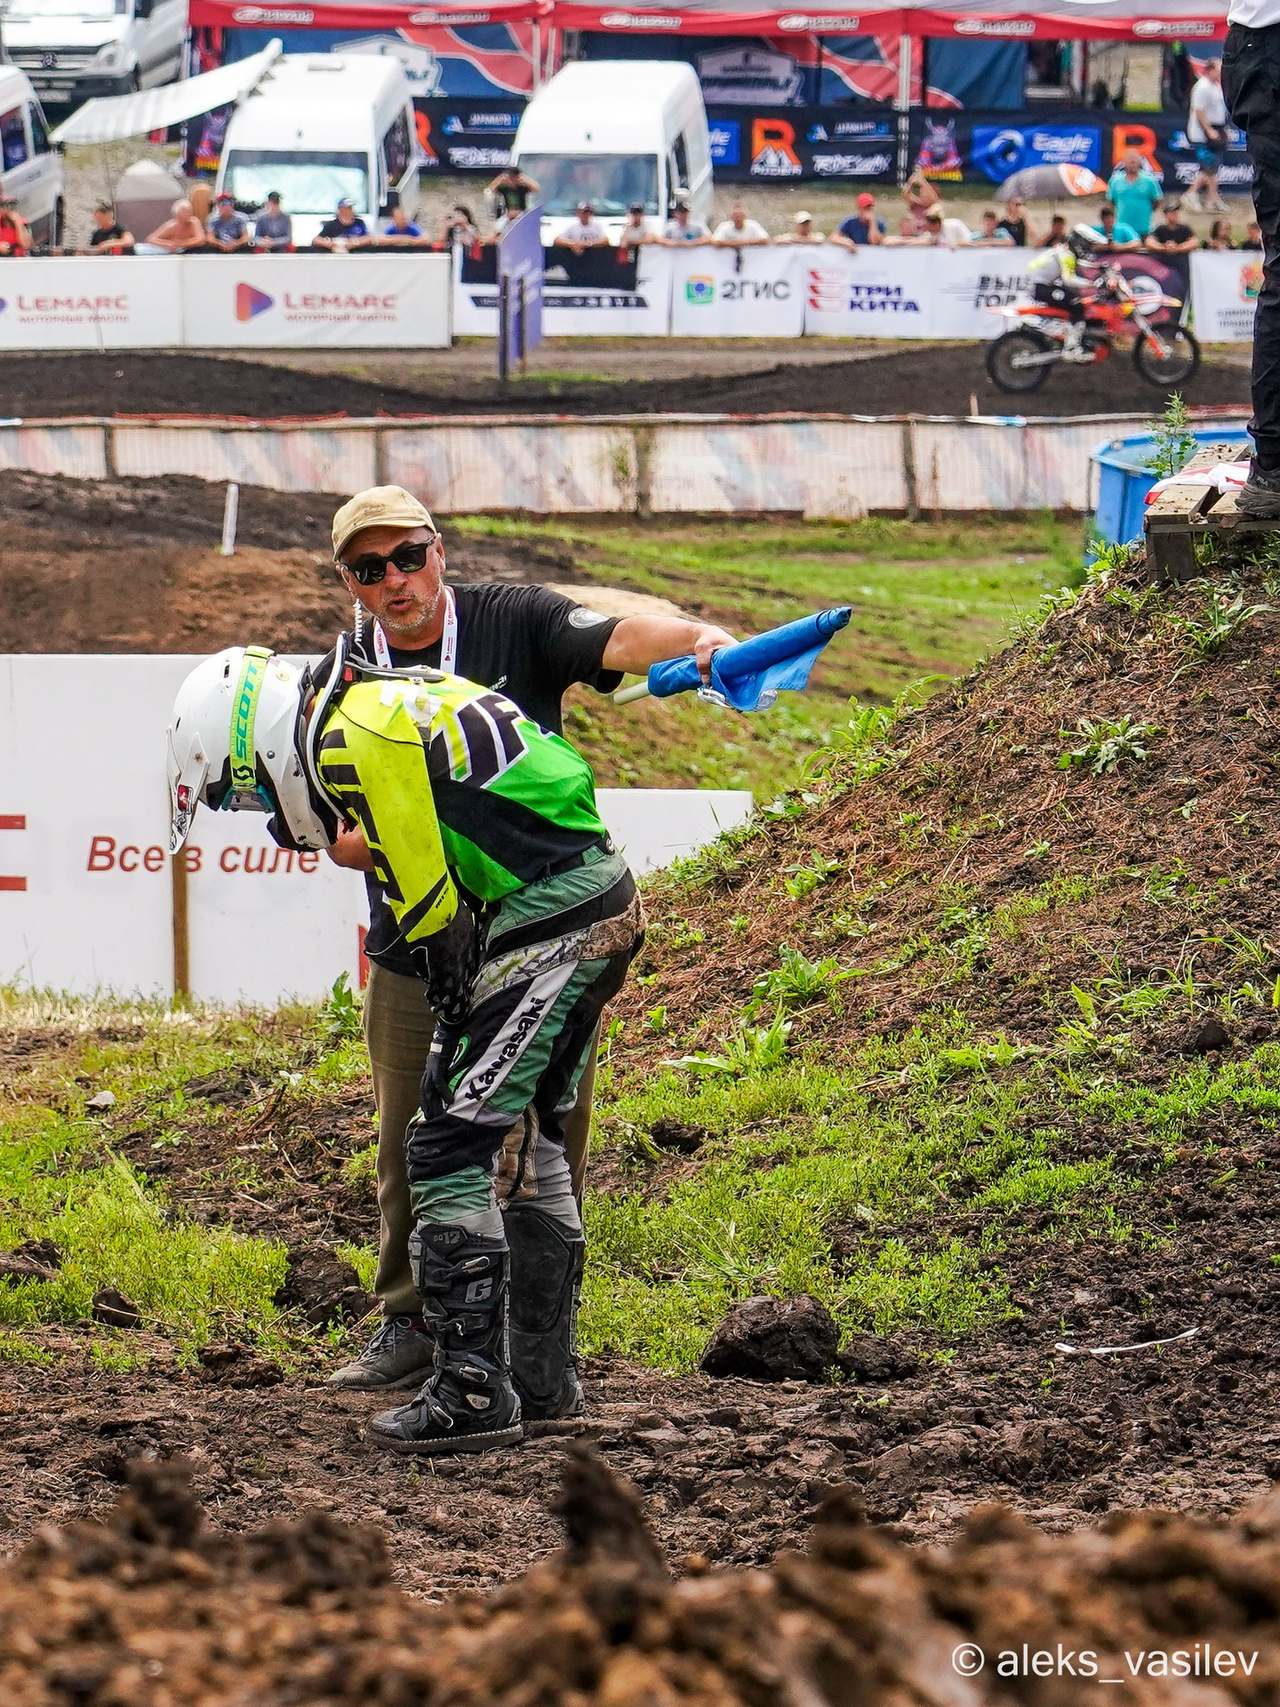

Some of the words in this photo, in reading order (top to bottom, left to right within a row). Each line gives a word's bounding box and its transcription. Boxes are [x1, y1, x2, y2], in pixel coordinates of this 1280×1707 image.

[1032, 133, 1093, 152] Eagle
[722, 280, 792, 300] 2ГИС
[851, 285, 903, 297] ТРИ
[17, 295, 129, 310] LEMARC
[284, 292, 398, 310] LEMARC
[850, 301, 920, 313] КИТА
[236, 661, 258, 761] SCOTT
[87, 836, 165, 873] Все
[220, 845, 320, 873] силе
[465, 997, 548, 1101] Kawasaki
